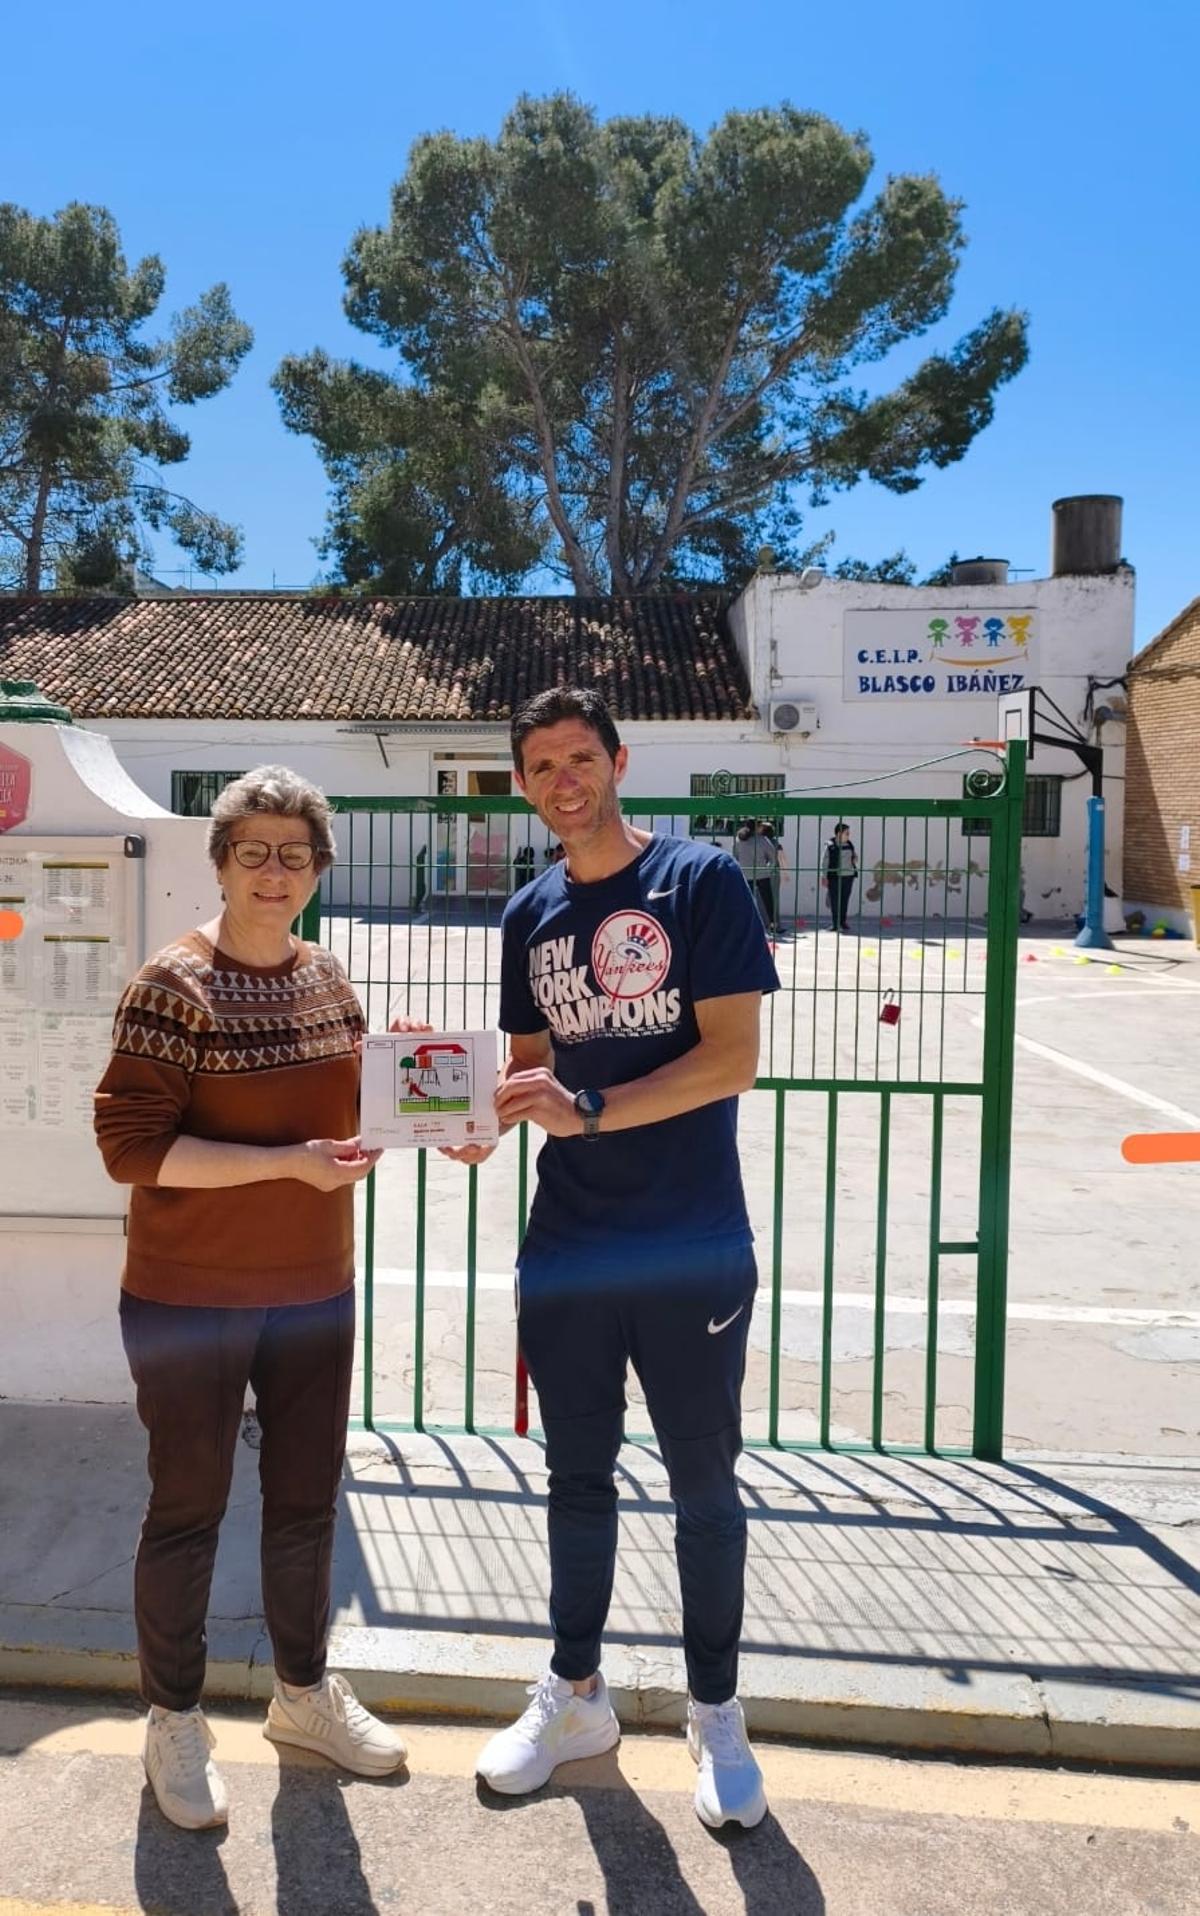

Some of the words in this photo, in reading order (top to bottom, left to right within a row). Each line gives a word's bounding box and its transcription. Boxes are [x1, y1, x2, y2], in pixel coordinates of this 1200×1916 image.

[858, 649, 923, 664] C.E.I.P.
[858, 675, 936, 694] BLASCO
[947, 669, 1024, 693] IBÁÑEZ
[529, 935, 576, 977] NEW
[597, 944, 664, 980] Yankees
[530, 965, 594, 1007] YORK
[539, 988, 681, 1036] HAMPIONS
